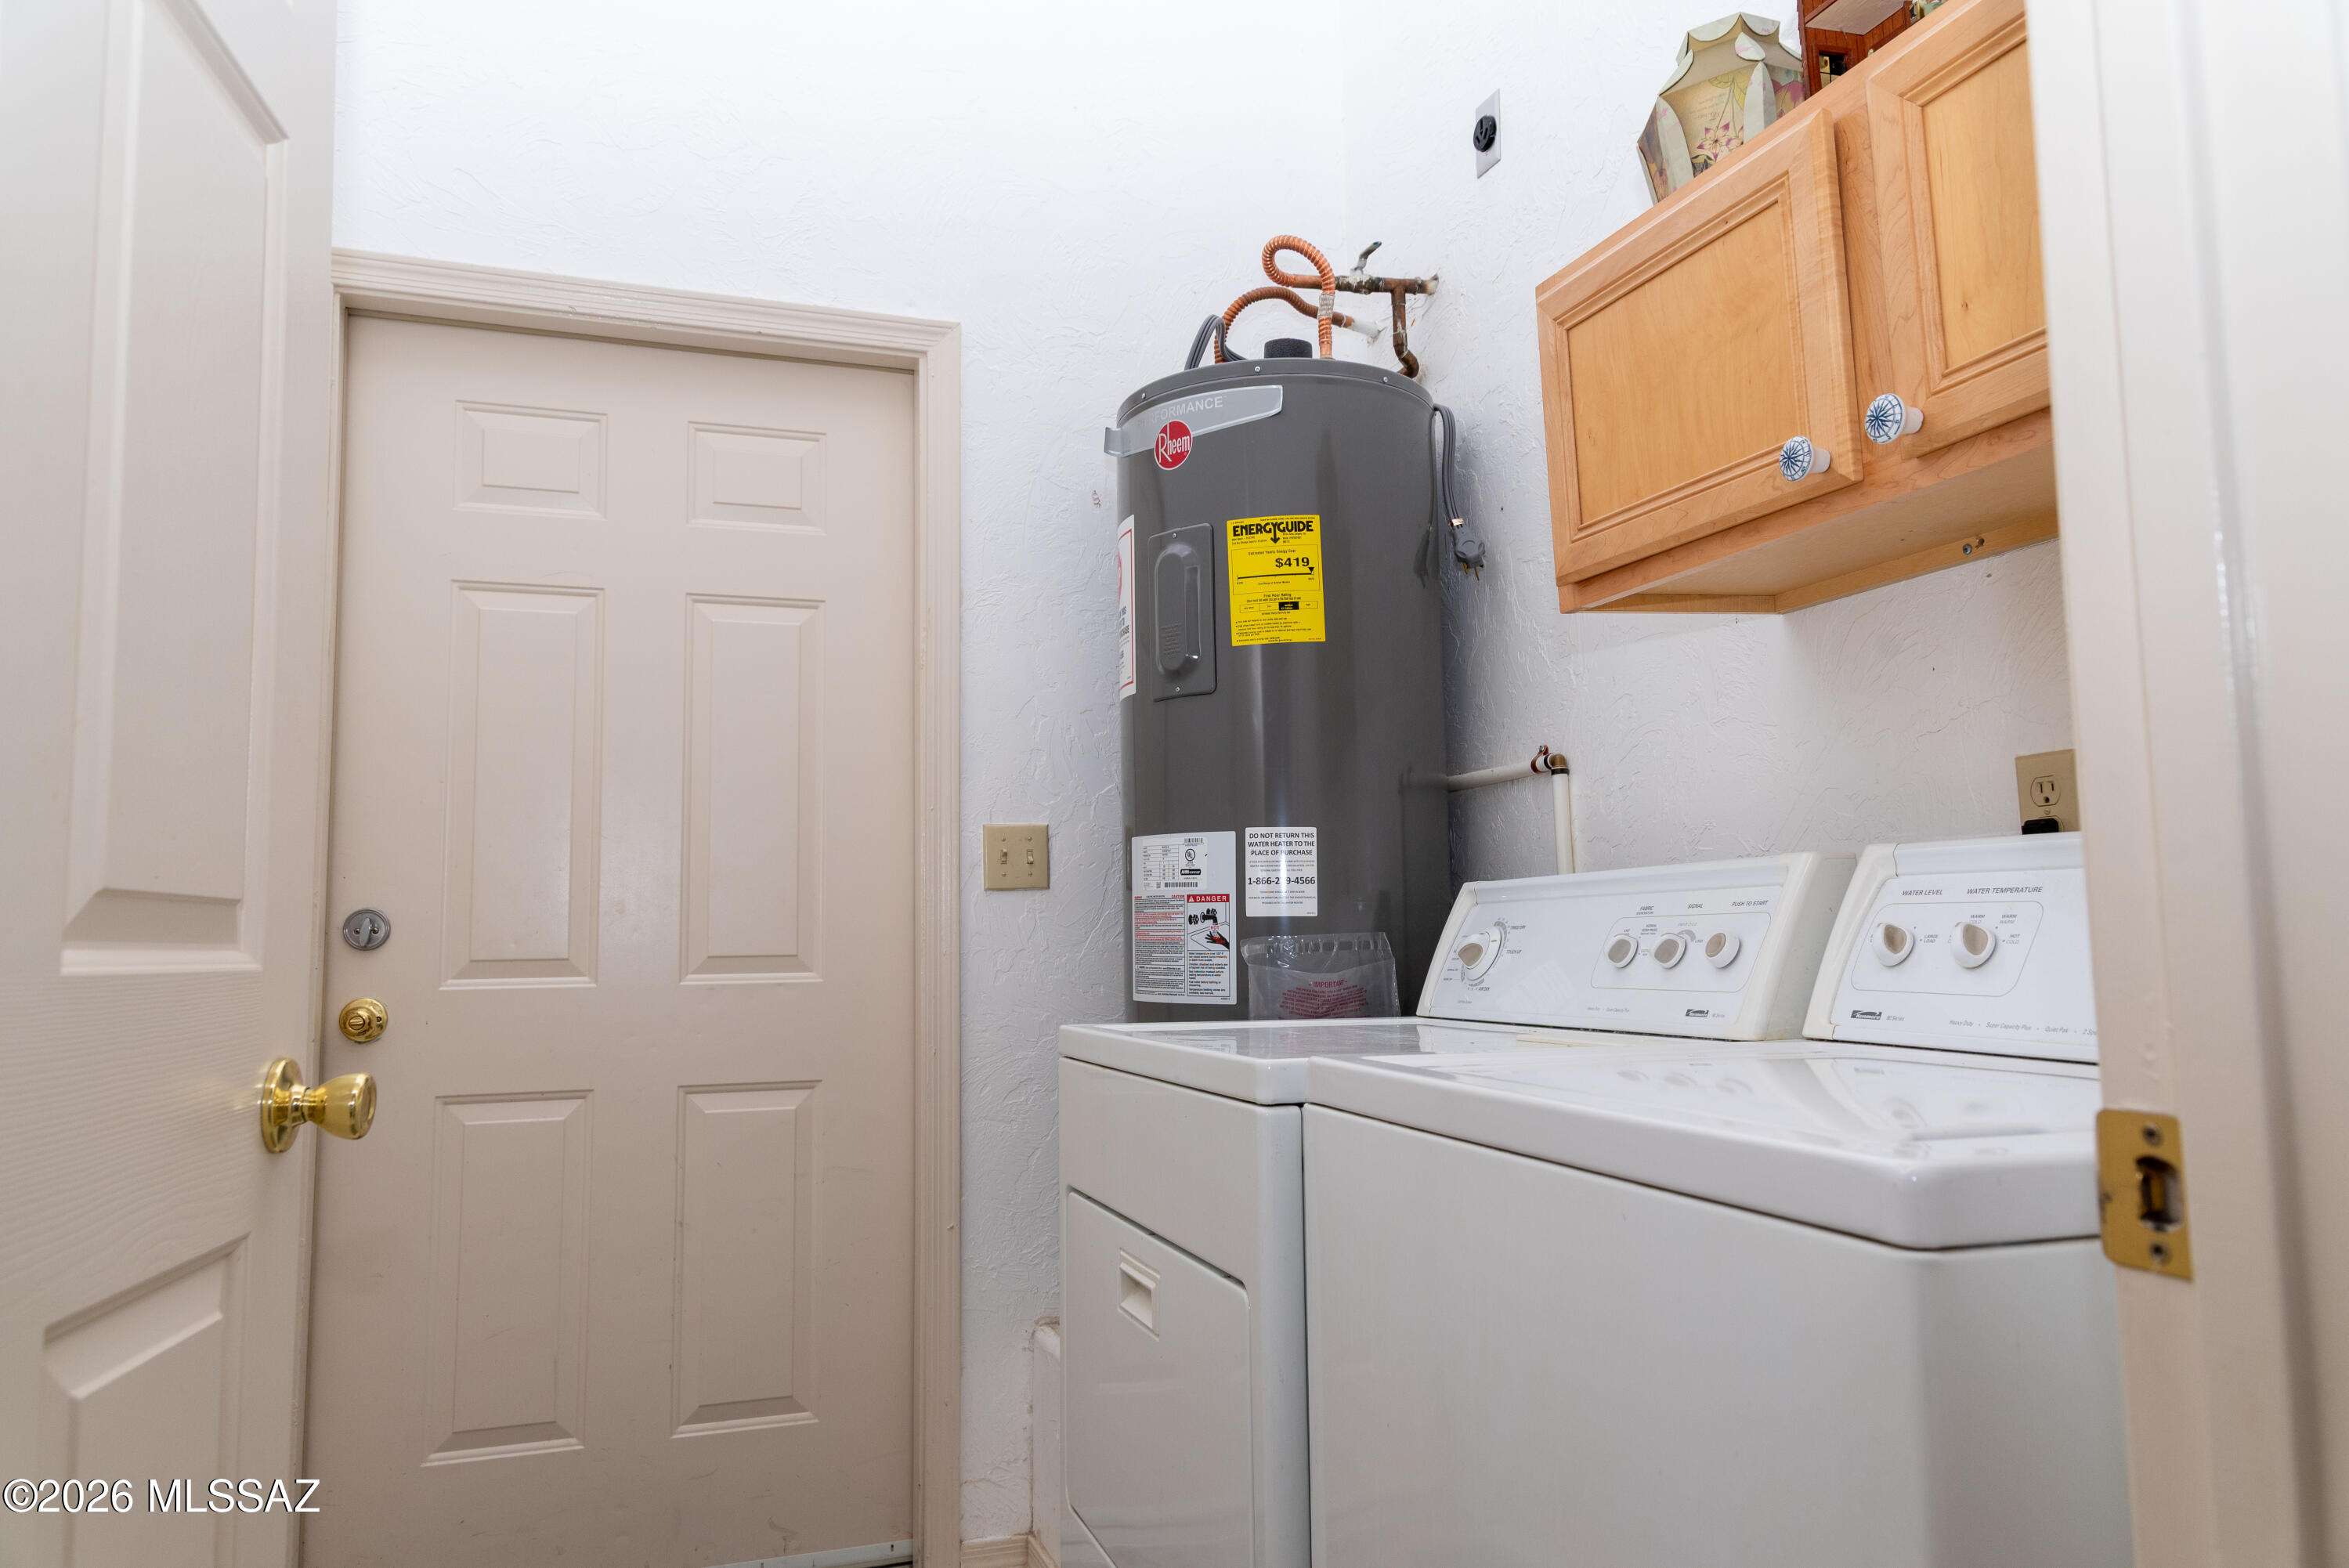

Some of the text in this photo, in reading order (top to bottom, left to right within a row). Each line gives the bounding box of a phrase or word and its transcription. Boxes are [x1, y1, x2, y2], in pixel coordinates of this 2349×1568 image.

[1140, 396, 1223, 425] RFORMANCE
[1158, 423, 1191, 463] Rheem
[1233, 521, 1314, 537] ENERGYGUIDE
[1275, 557, 1310, 569] $419
[1248, 876, 1316, 885] 1-866-29-4566
[1313, 979, 1344, 988] IMPORTANT
[2000, 1022, 2020, 1031] Capacity
